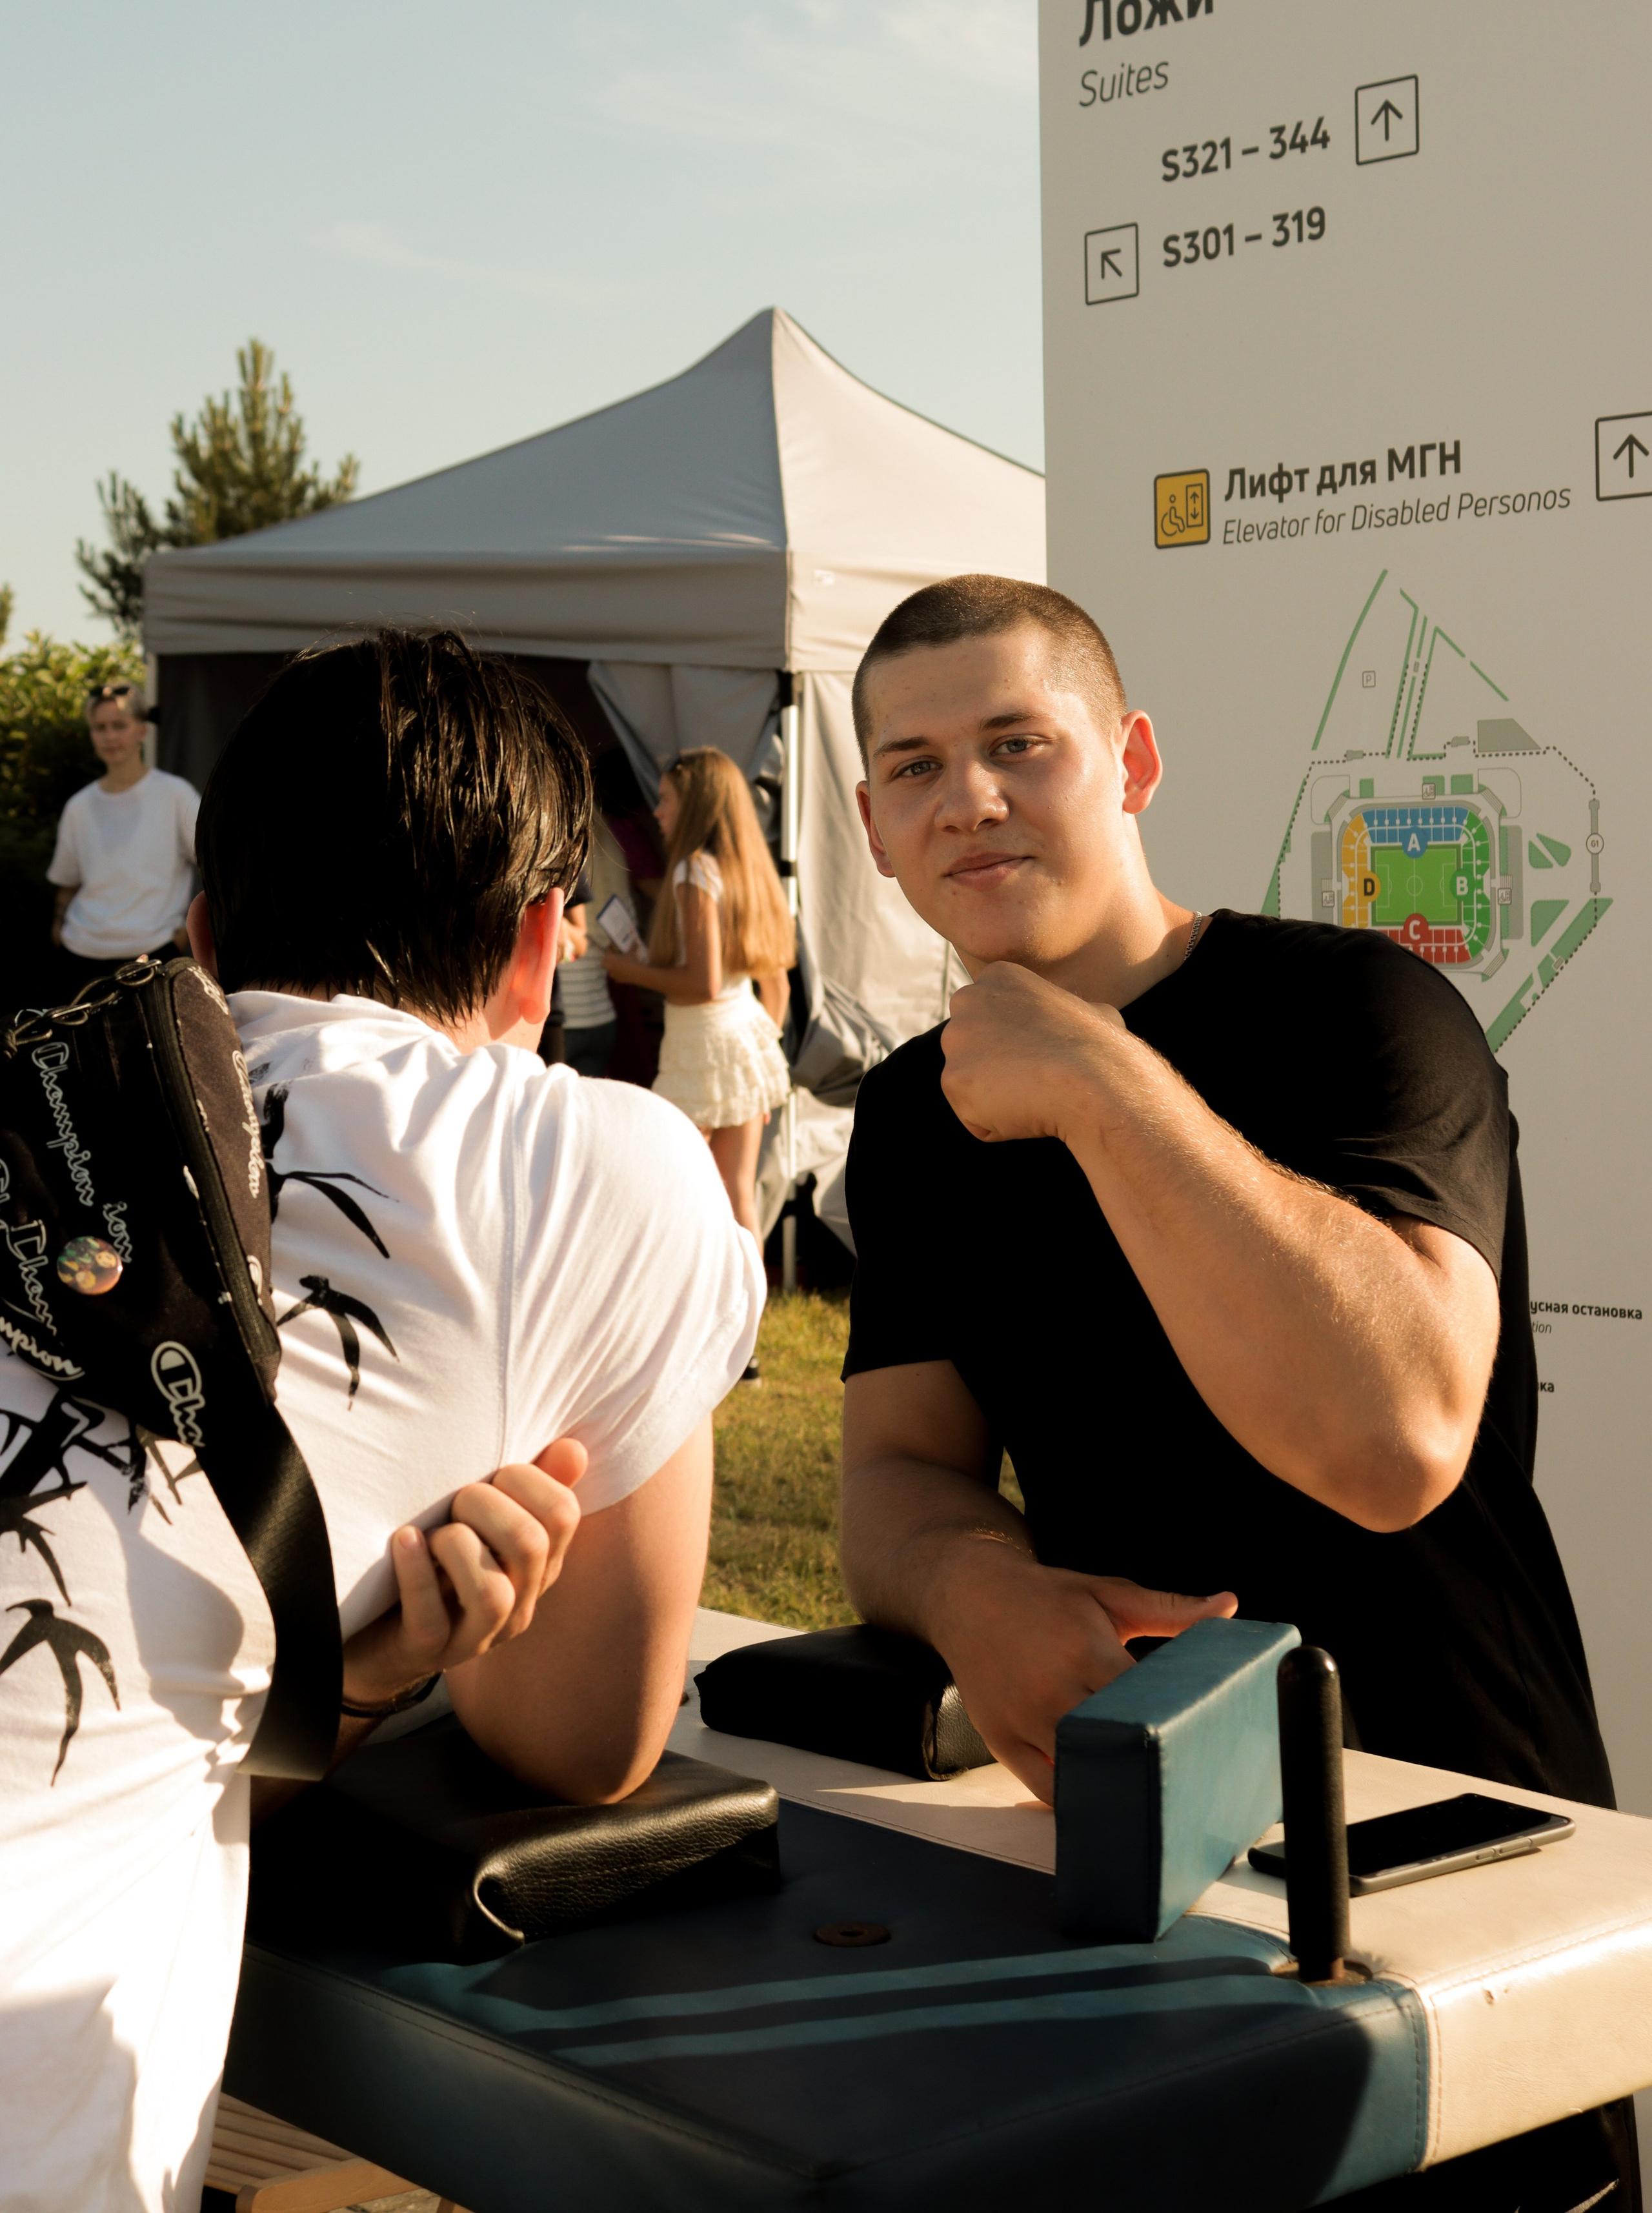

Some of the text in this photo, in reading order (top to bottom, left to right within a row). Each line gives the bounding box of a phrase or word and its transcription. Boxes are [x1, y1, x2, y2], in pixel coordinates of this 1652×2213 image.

[1079, 61, 1169, 107] Suites
[1162, 137, 1231, 183] S321
[1269, 116, 1331, 160] 344
[1162, 223, 1234, 268] S301
[1272, 206, 1325, 248] 319
[1225, 440, 1460, 503] Лифт для МГН
[1223, 488, 1571, 545] Elevator for Disabled Personos
[1407, 833, 1421, 852] A
[1364, 878, 1376, 896] D
[1456, 876, 1469, 896] B
[1409, 920, 1421, 940] C
[32, 1042, 95, 1207] Champion
[1572, 1304, 1642, 1320] остановка
